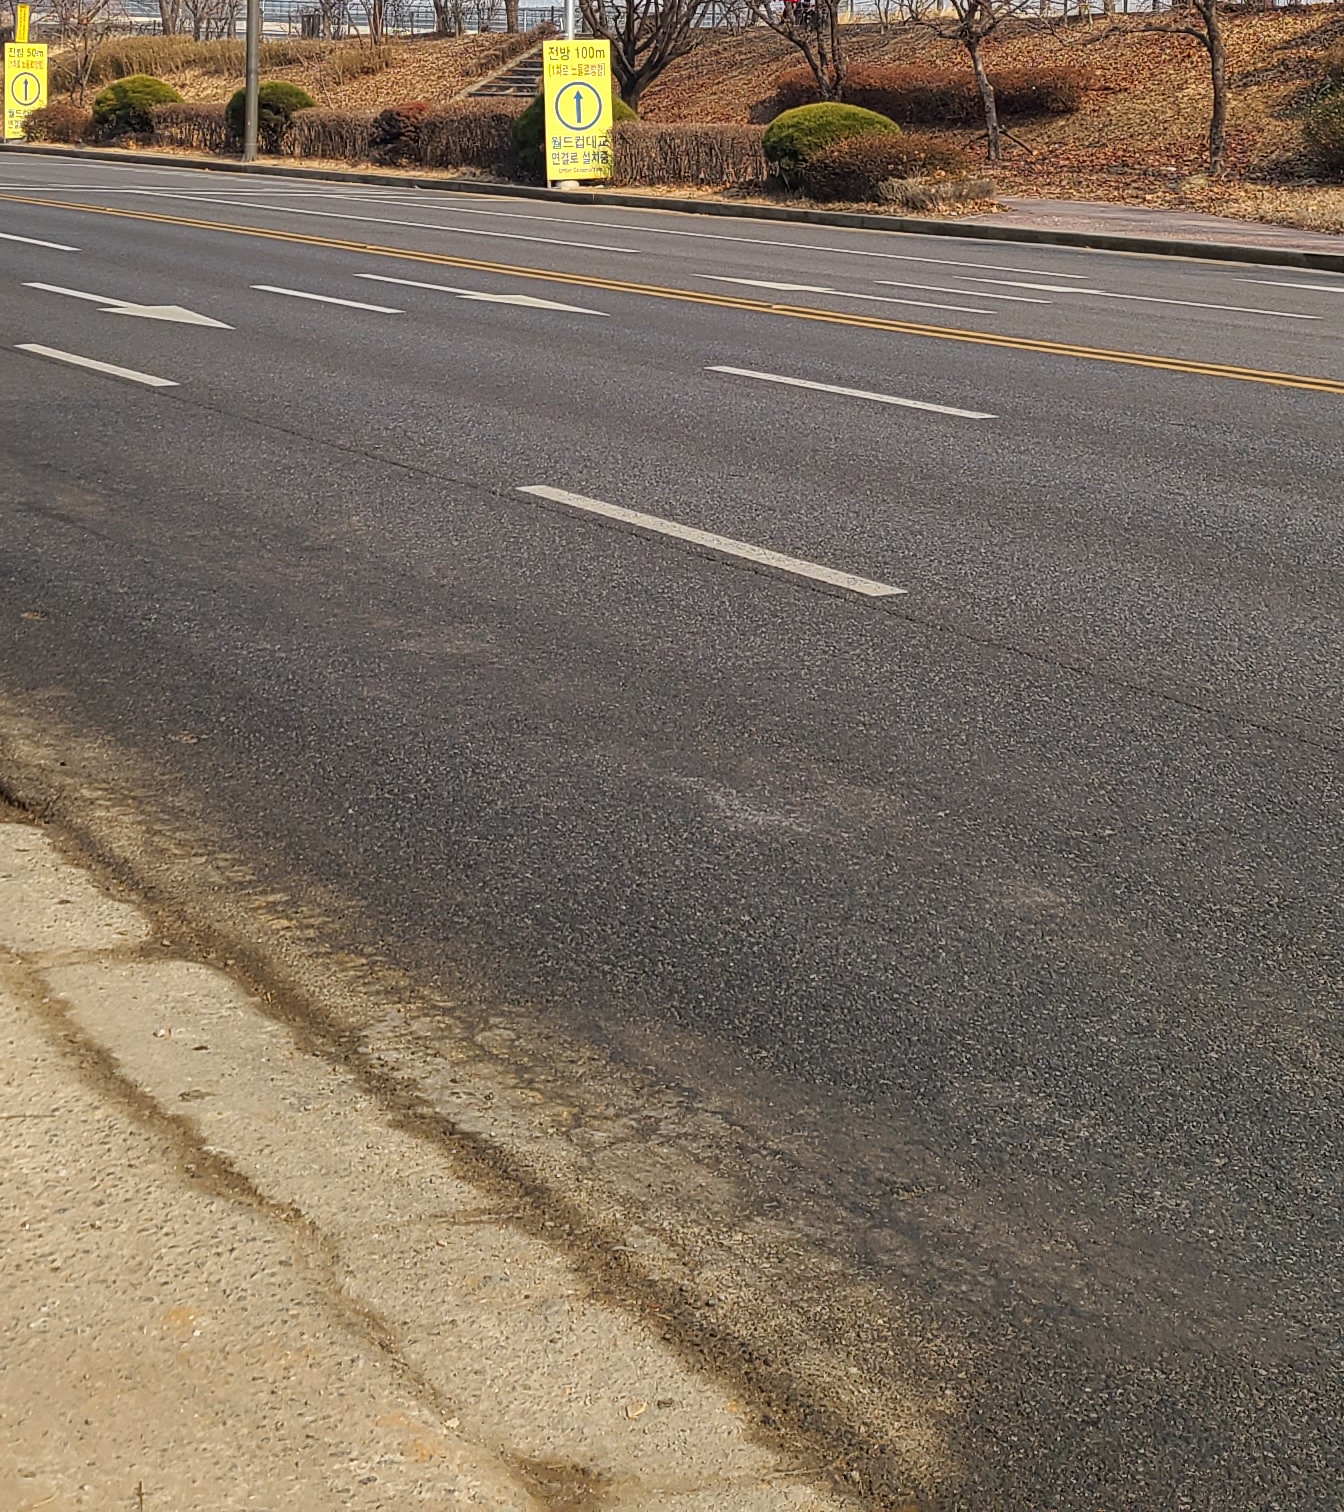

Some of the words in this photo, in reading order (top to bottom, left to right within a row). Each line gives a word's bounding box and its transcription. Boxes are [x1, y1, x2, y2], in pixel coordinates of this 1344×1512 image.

[548, 46, 570, 61] 전방
[574, 46, 605, 59] 100m
[551, 135, 609, 150] 월드컵대교
[551, 152, 579, 165] 연결로
[583, 150, 609, 165] 설치중
